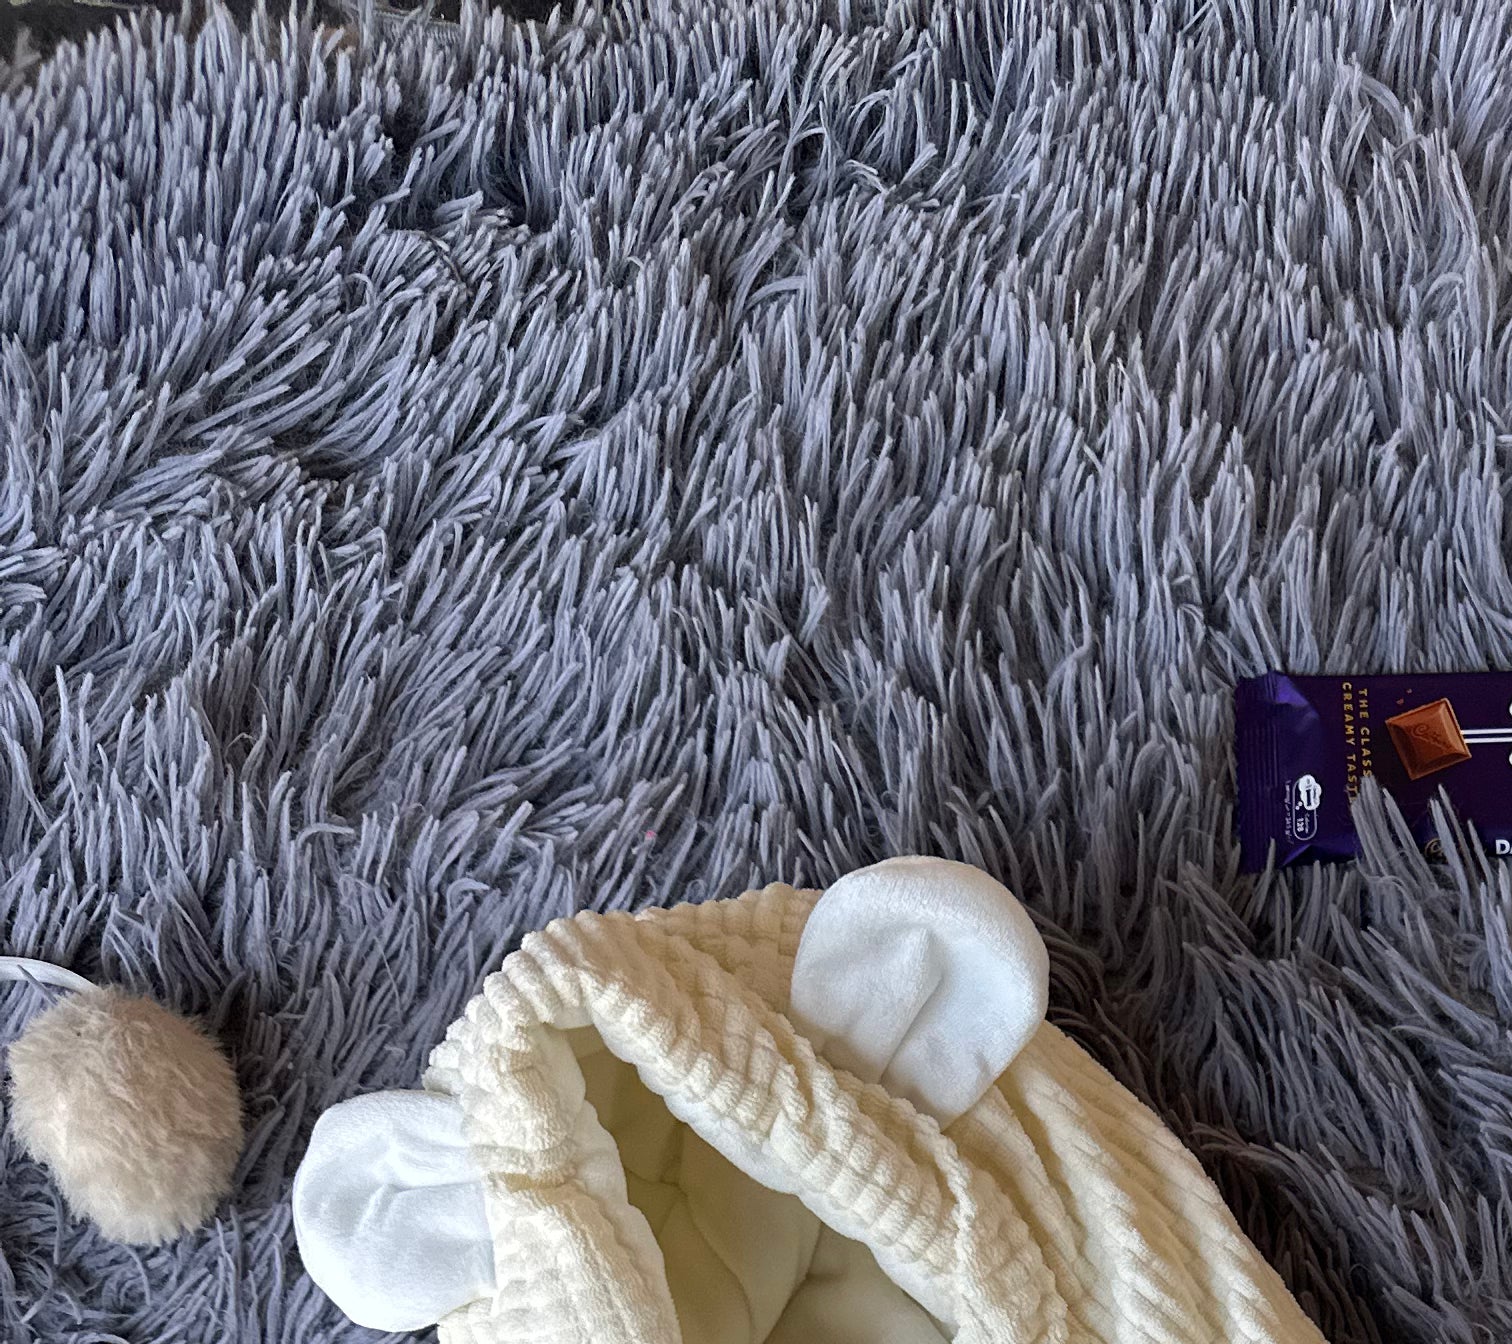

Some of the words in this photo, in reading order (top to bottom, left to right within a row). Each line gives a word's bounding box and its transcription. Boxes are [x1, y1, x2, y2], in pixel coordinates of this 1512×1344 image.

[1342, 681, 1356, 746] CREAMY
[1357, 688, 1370, 719] THE
[1360, 726, 1374, 779] CLASS
